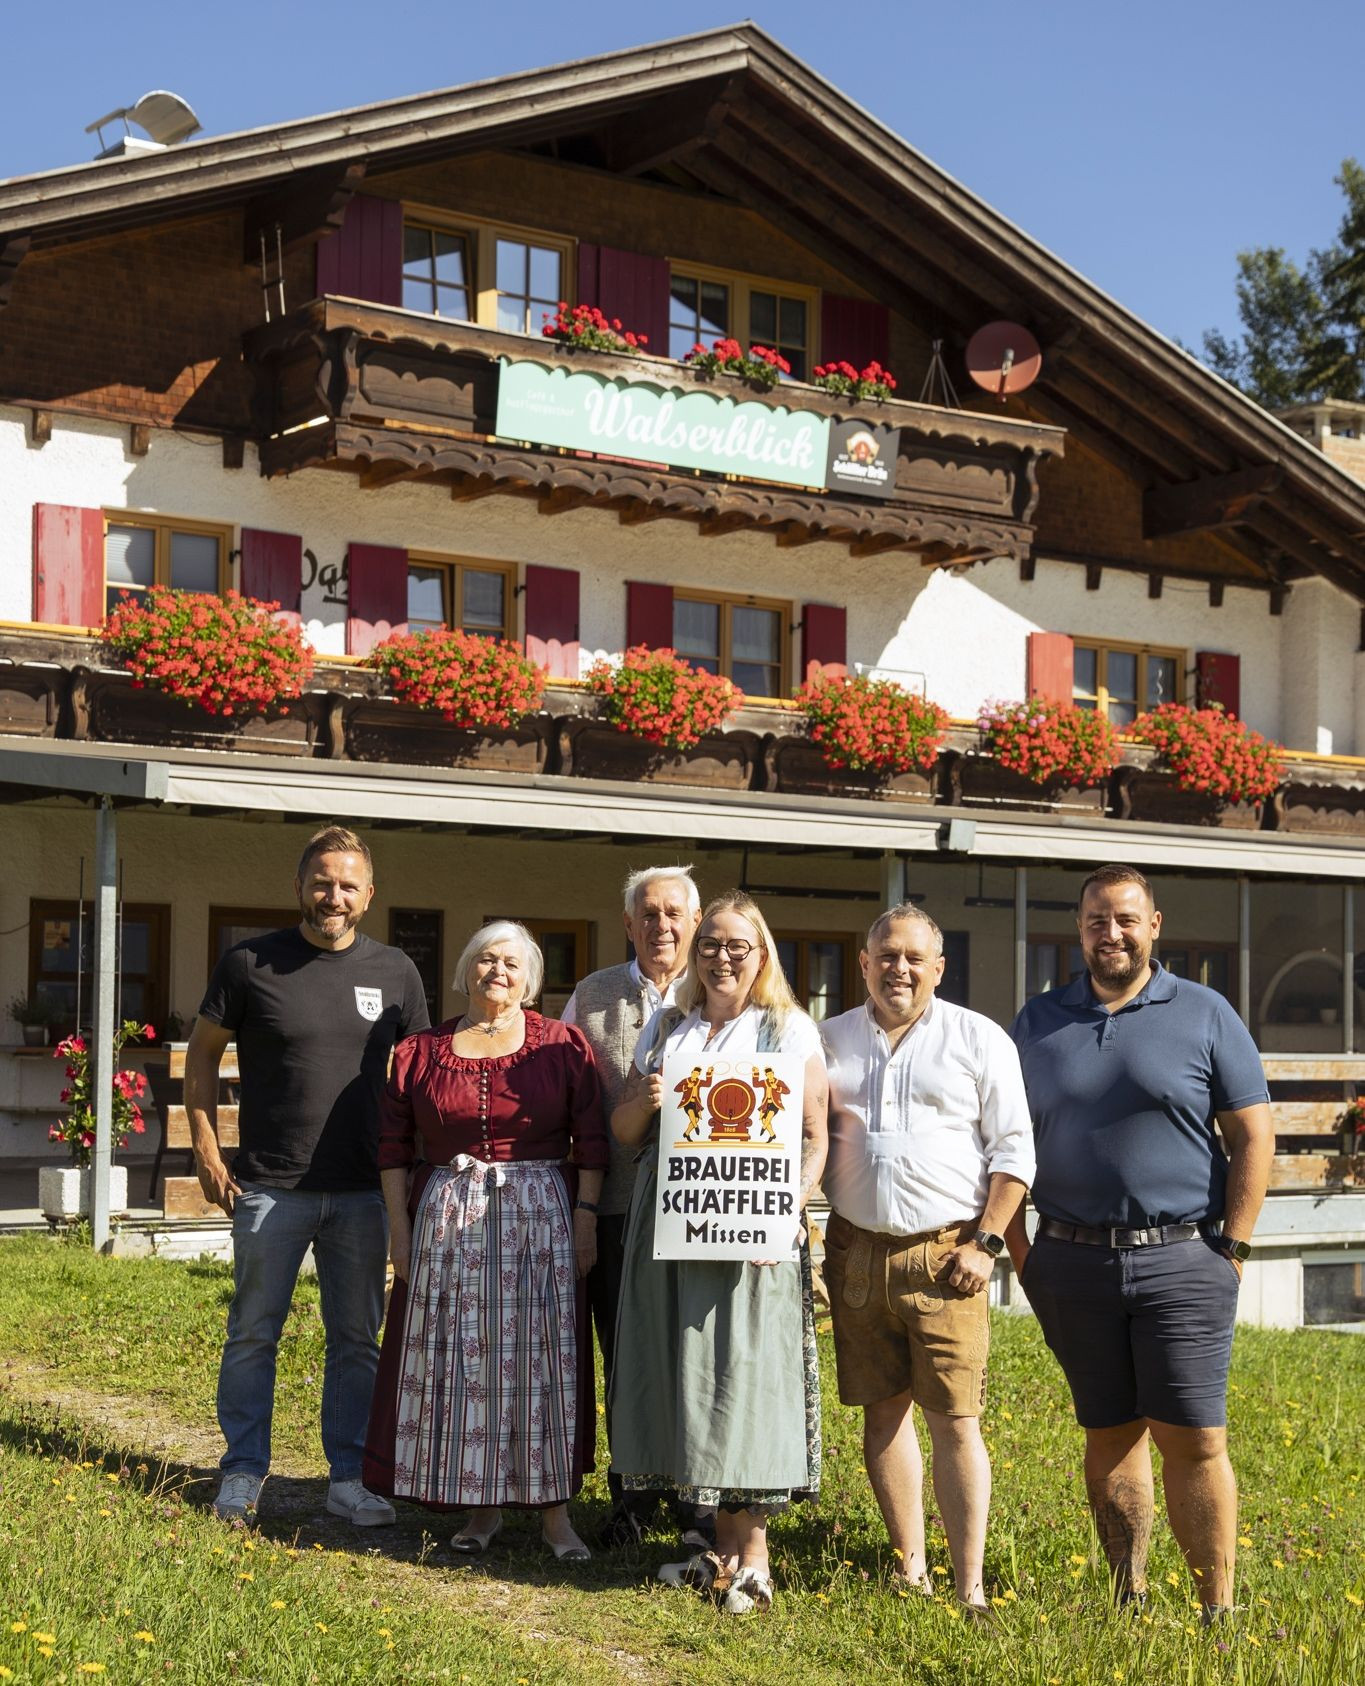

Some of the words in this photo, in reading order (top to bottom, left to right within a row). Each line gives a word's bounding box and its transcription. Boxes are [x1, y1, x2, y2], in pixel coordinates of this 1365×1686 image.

[584, 388, 814, 470] Walserblick
[667, 1156, 791, 1184] BRAUEREI
[662, 1188, 794, 1216] SCHÄFFLER
[685, 1219, 767, 1244] Missen
